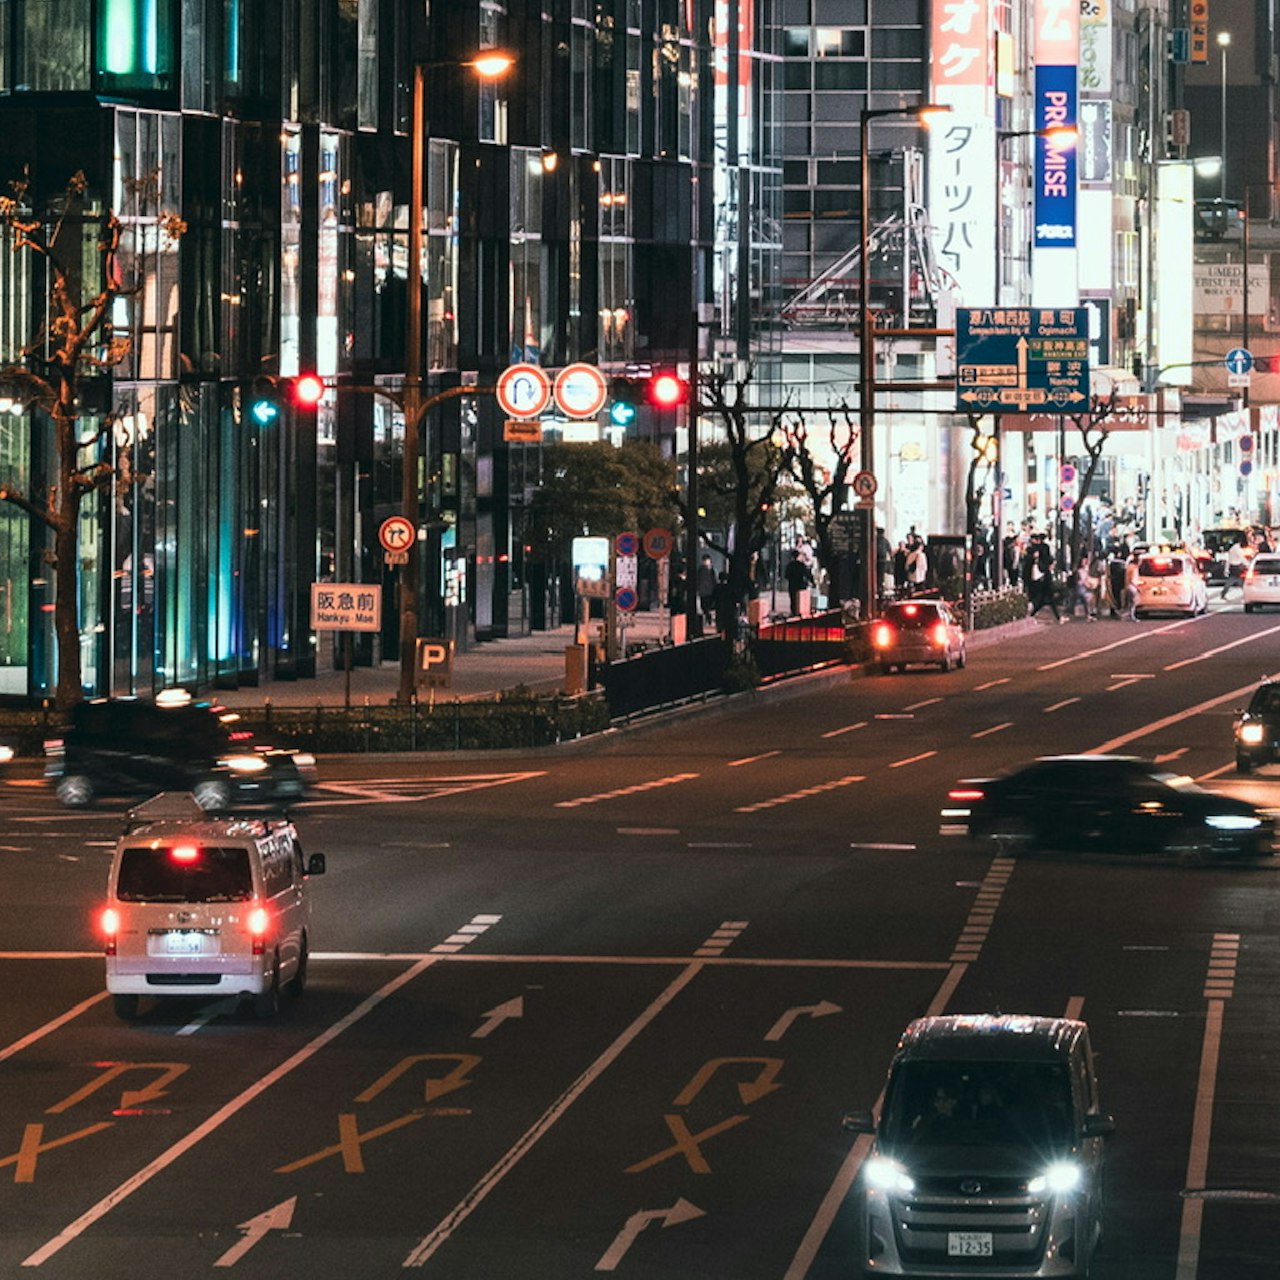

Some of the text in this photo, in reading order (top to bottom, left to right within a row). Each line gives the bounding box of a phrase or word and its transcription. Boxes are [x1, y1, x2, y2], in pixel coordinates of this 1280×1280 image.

[1208, 266, 1244, 277] UMED
[1038, 326, 1077, 336] Ogimachi
[1049, 377, 1079, 386] Namba
[317, 591, 374, 611] 阪急前
[422, 644, 446, 670] P
